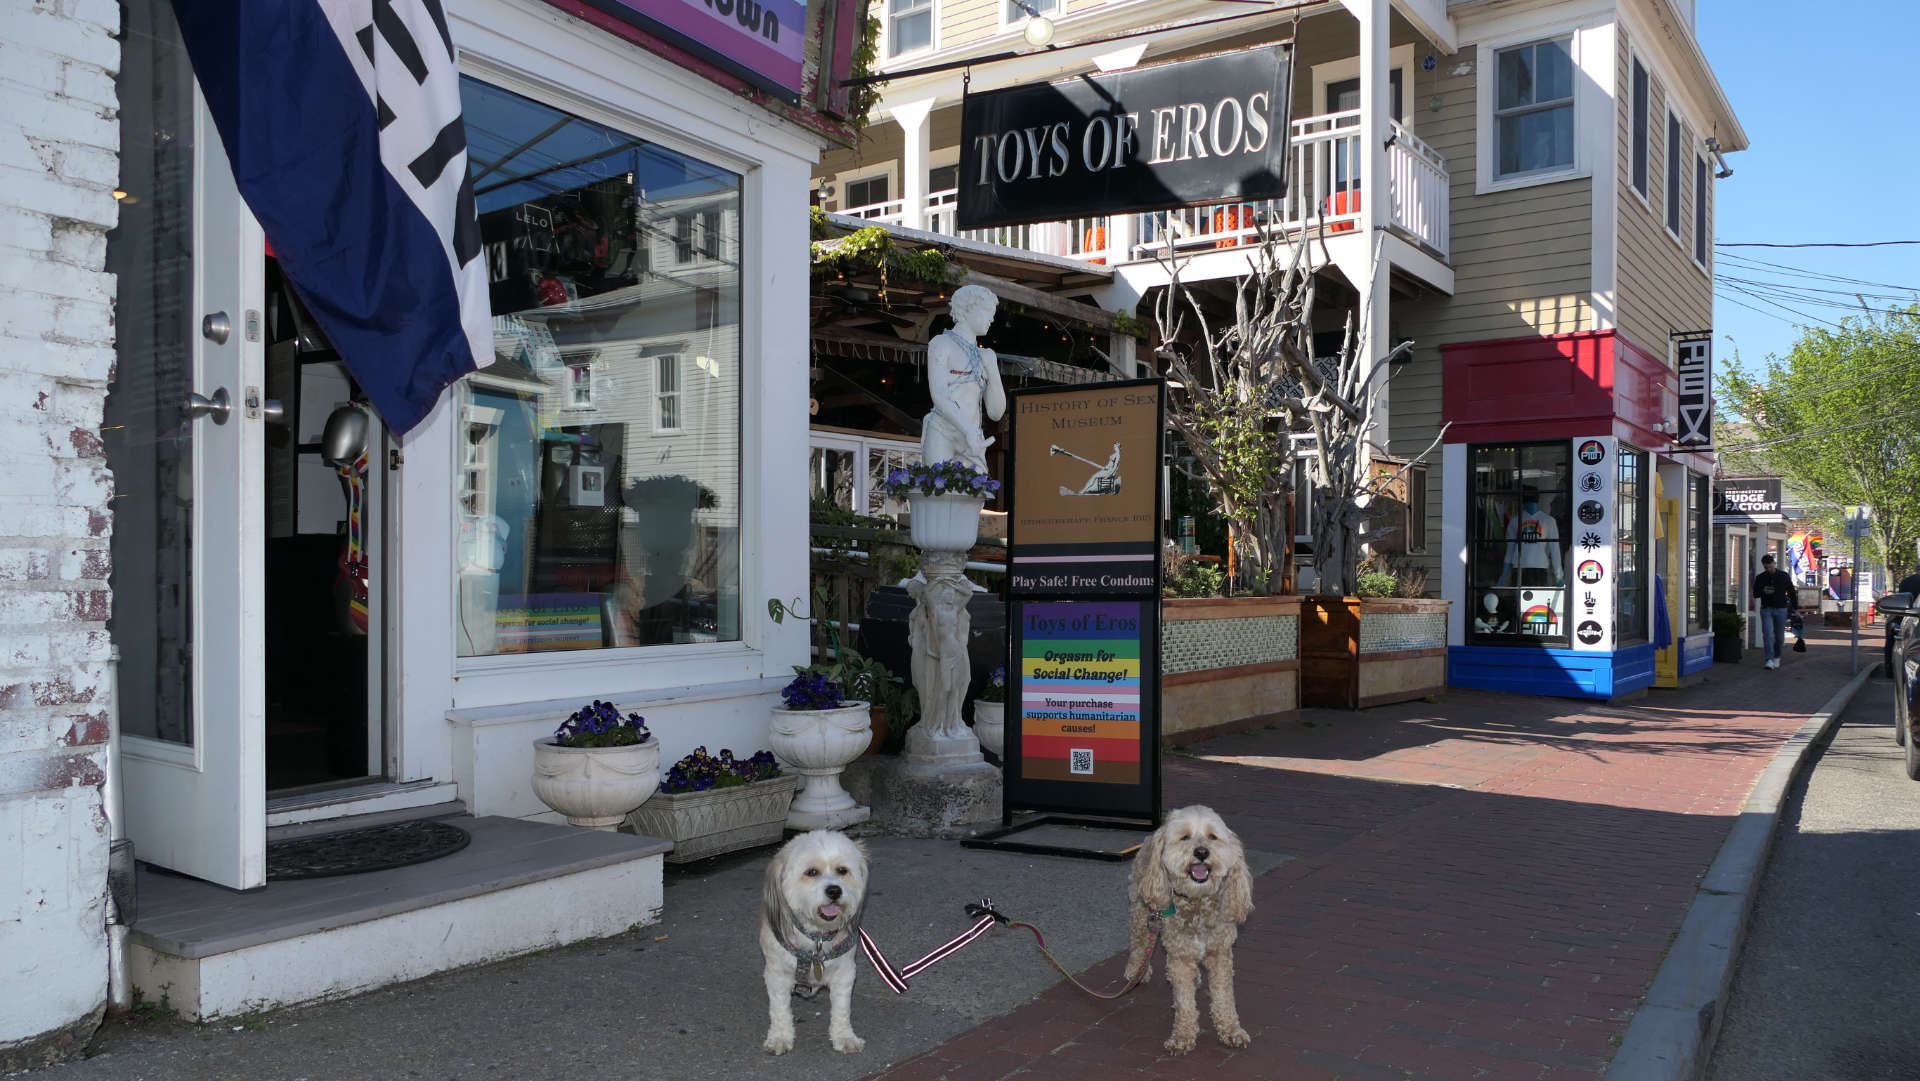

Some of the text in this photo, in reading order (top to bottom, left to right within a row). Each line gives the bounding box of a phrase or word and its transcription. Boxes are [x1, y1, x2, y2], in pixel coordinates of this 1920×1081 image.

[973, 89, 1271, 187] TOYS OF EROS
[514, 210, 549, 229] LELO
[1021, 393, 1157, 415] HISTORY OF SEX
[1050, 415, 1123, 430] MUSEUM
[1725, 494, 1765, 503] FUDGE
[1725, 502, 1778, 512] FACTORY
[1011, 575, 1037, 590] Play
[1039, 575, 1068, 587] Safe!
[1071, 575, 1097, 587] Free
[1027, 613, 1137, 636] Toys of Eros
[1043, 649, 1116, 665] Orgasm for
[1032, 667, 1128, 683] Social Change!
[1045, 697, 1114, 710] Your purchase
[1026, 710, 1136, 722] supports humanitarian
[1060, 724, 1096, 734] causes!
